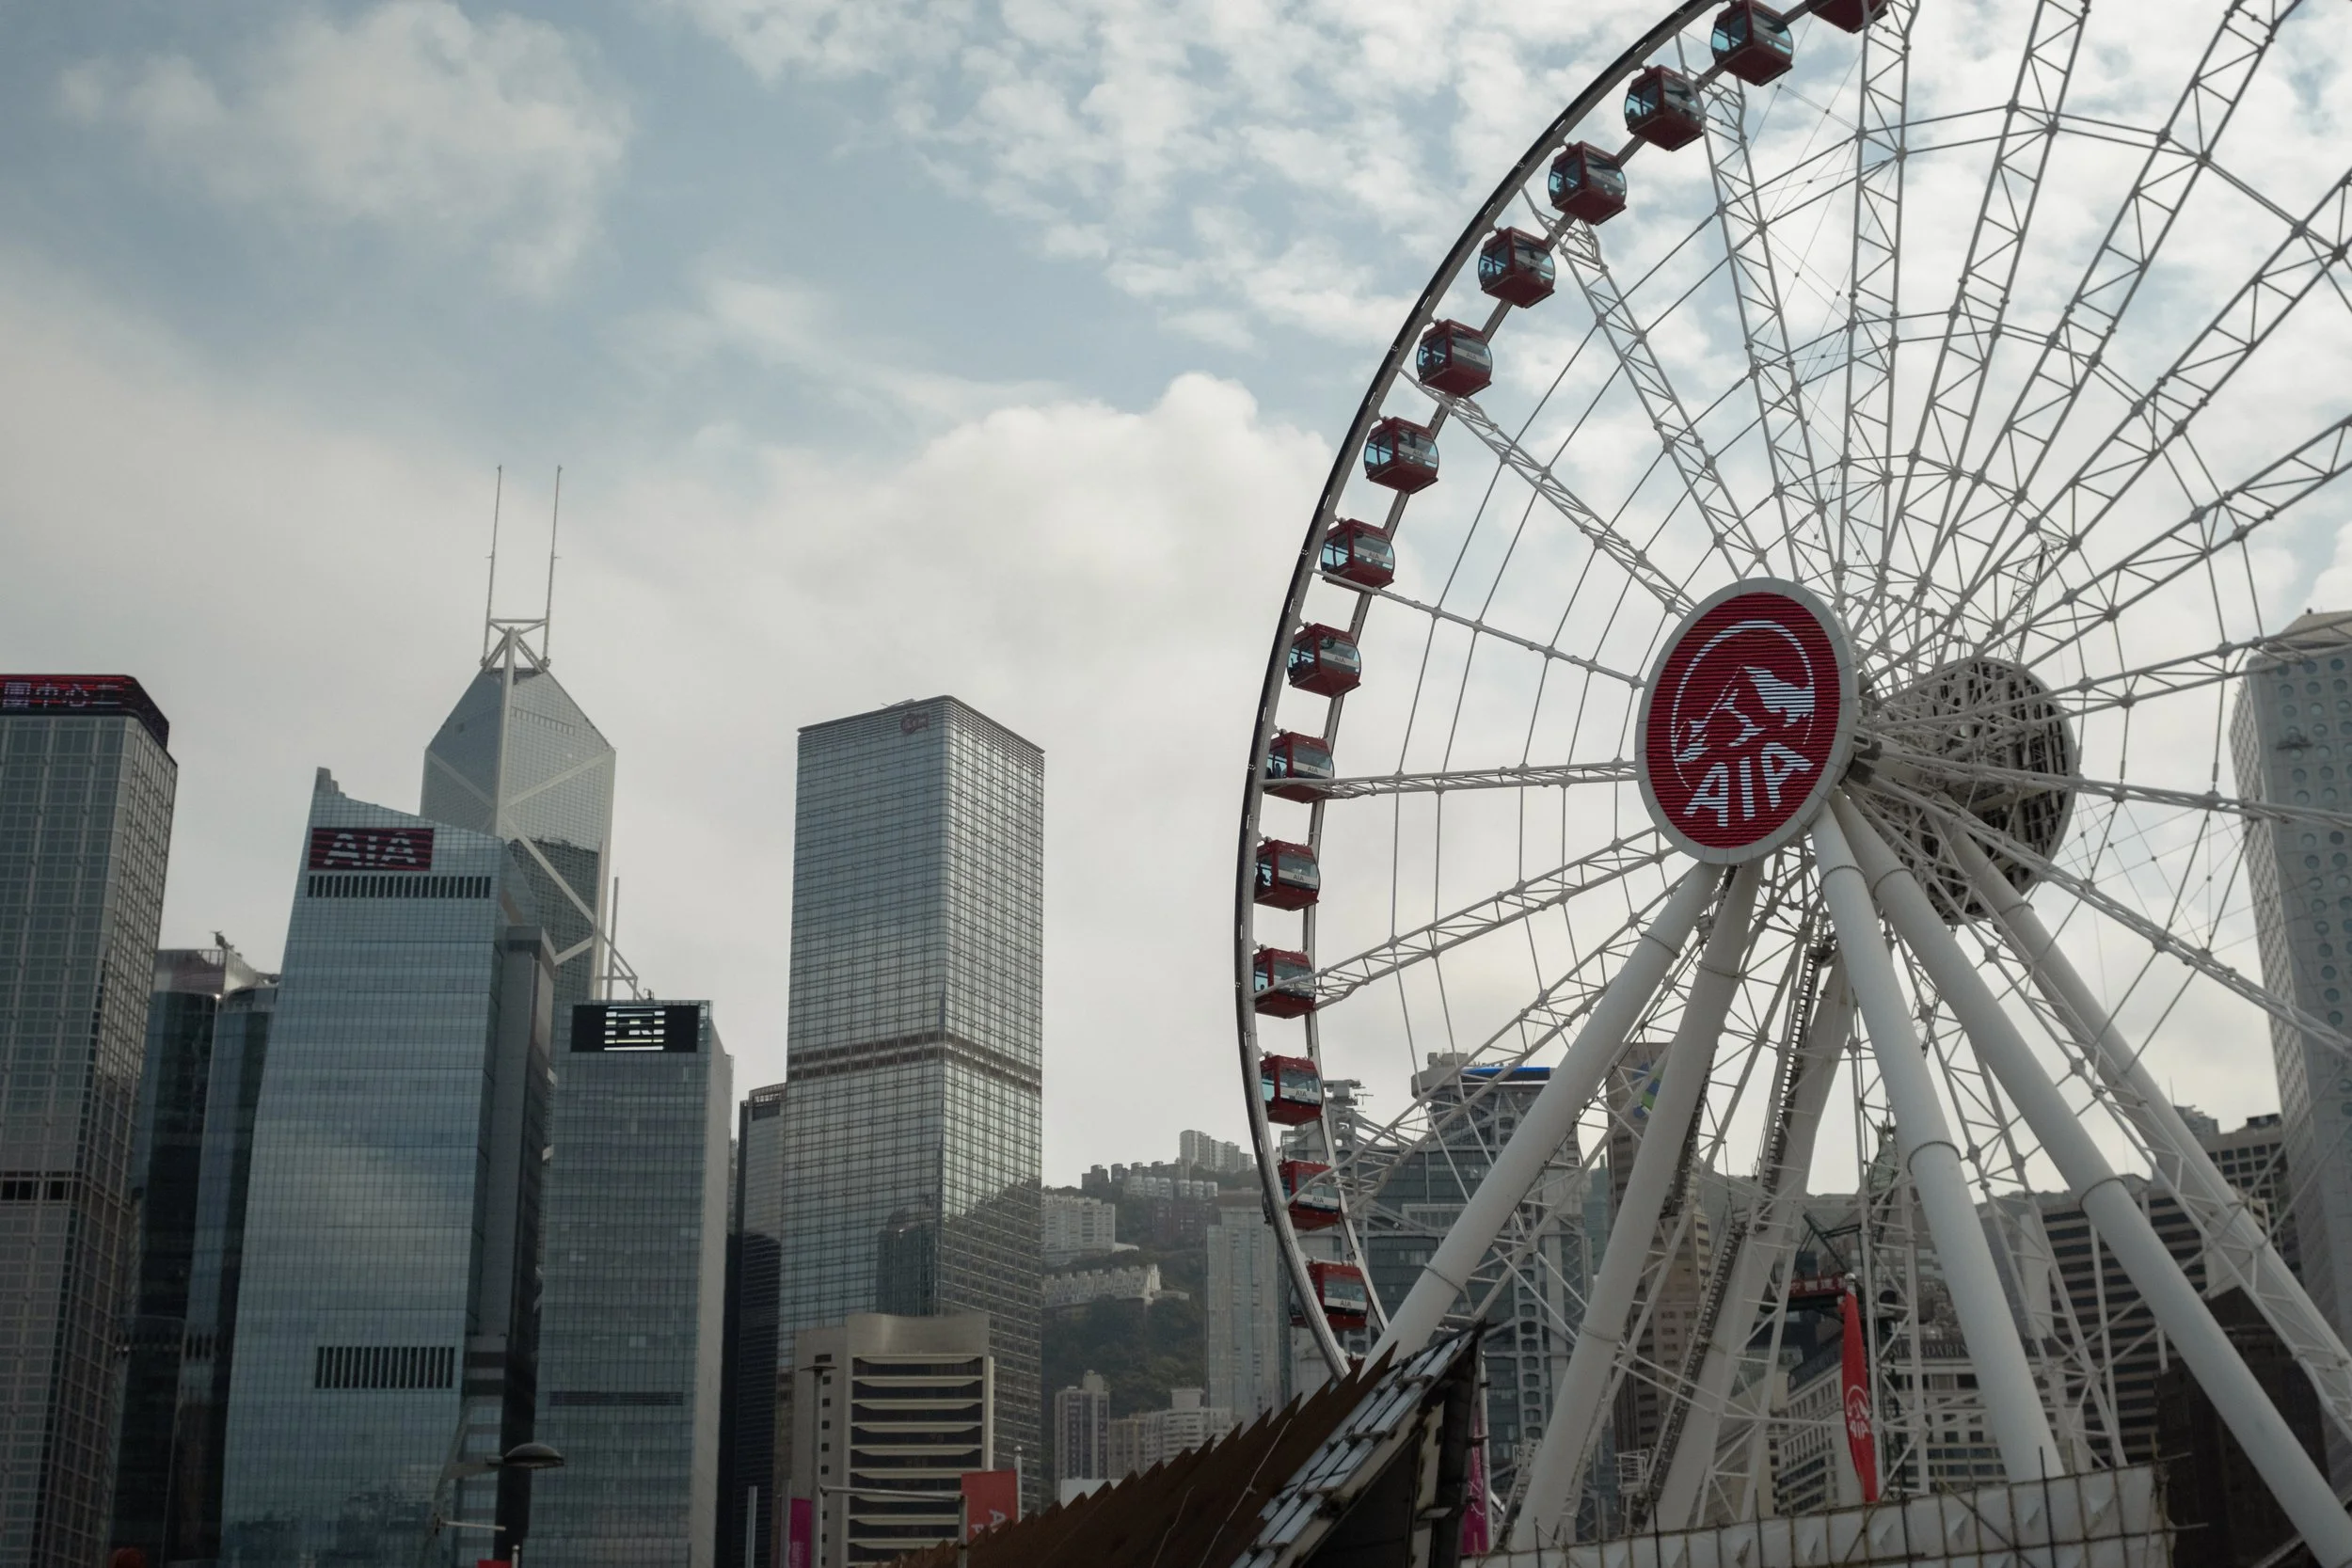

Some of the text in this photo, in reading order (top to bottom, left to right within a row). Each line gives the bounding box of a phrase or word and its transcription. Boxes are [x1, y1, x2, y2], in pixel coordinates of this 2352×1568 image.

[1368, 551, 1379, 560] AIA
[1334, 656, 1345, 664] AIA
[1307, 766, 1318, 774] AIA
[1682, 742, 1815, 827] AIA
[323, 832, 417, 867] AIA
[1311, 1196, 1324, 1204] AIA
[1850, 1419, 1869, 1441] AIA
